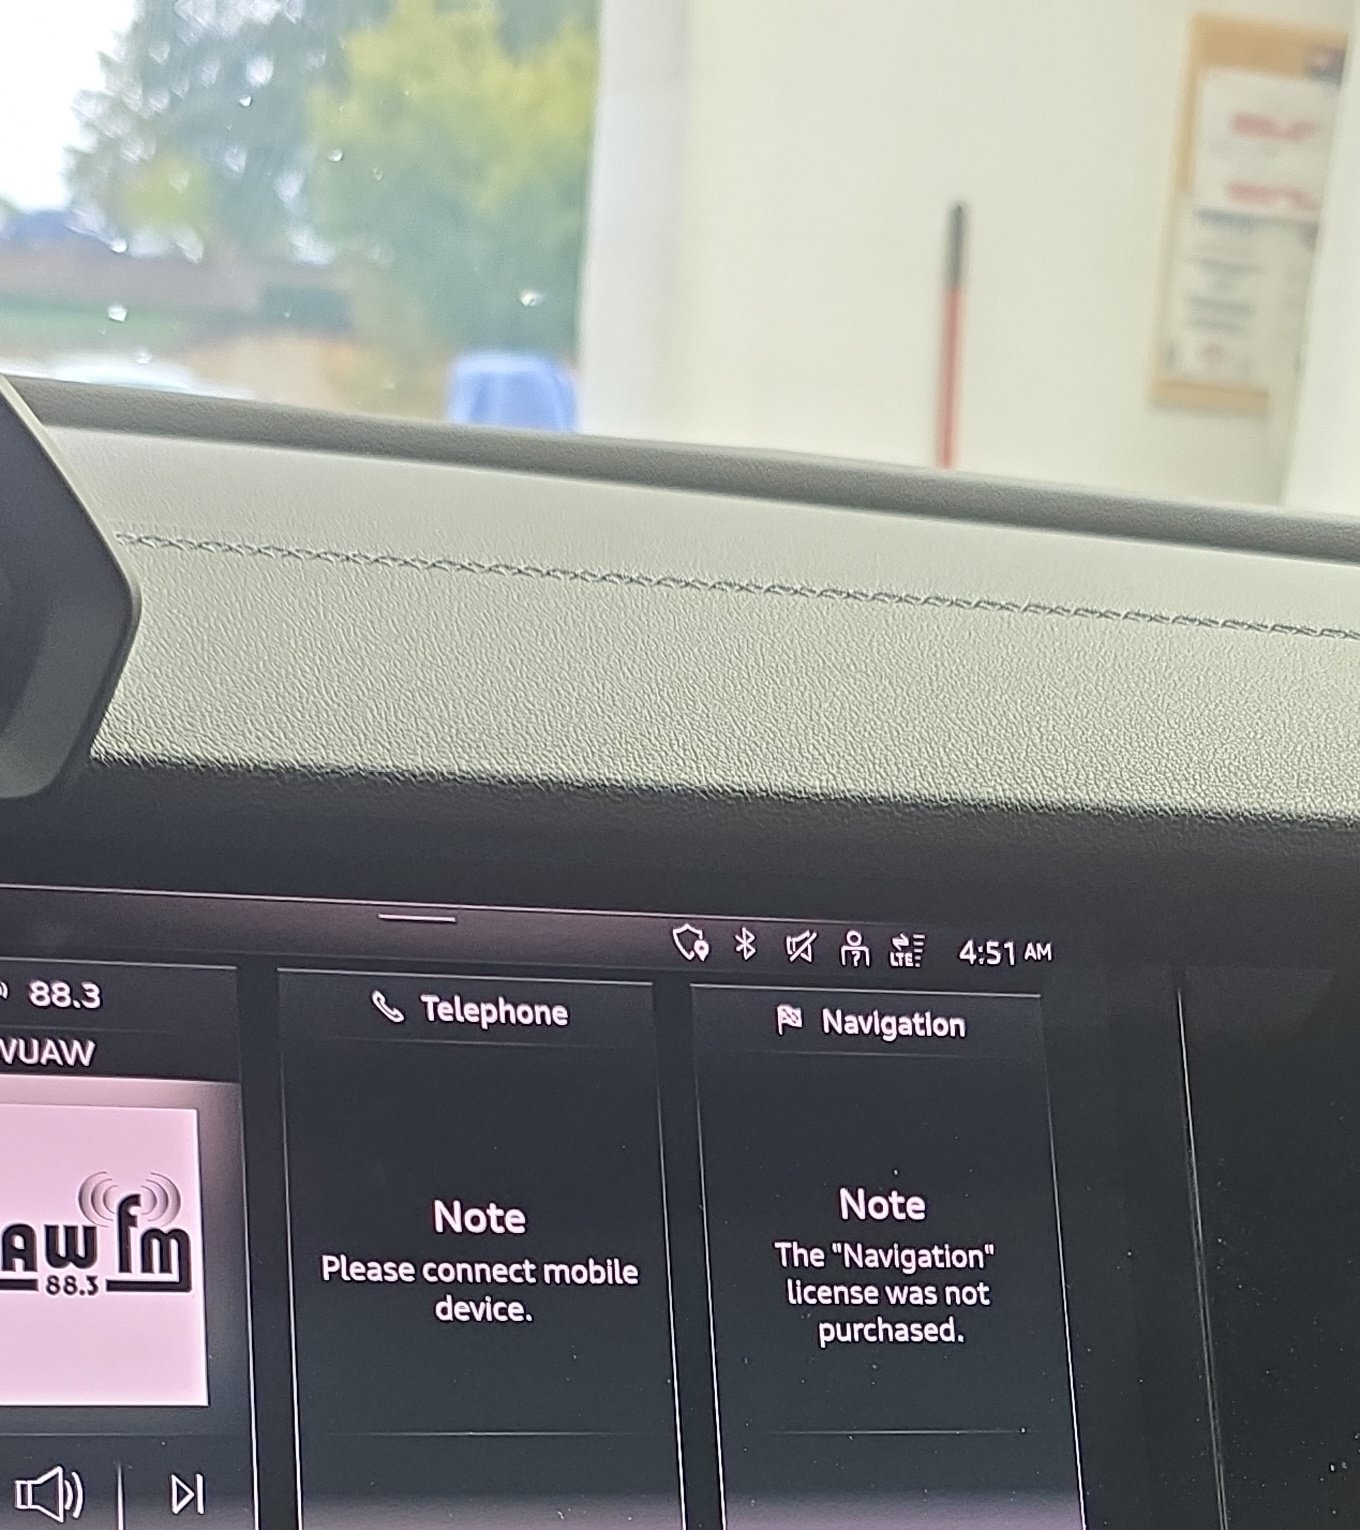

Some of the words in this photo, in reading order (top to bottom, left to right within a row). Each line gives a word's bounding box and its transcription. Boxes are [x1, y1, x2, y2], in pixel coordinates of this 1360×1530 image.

[889, 951, 915, 968] LTE
[959, 940, 1016, 966] 4:51
[1024, 943, 1052, 961] AM
[29, 981, 101, 1009] 88.3
[421, 994, 569, 1030] Telephone
[822, 1008, 966, 1042] Navigation
[434, 1199, 526, 1234] Note
[839, 1187, 926, 1220] Note
[322, 1254, 416, 1282] Please
[423, 1259, 537, 1284] connect
[543, 1257, 639, 1285] mobile
[774, 1241, 825, 1268] The
[831, 1242, 994, 1275] "Navigation"
[45, 1275, 99, 1296] 88.3
[787, 1278, 880, 1305] license
[885, 1285, 938, 1306] was
[944, 1281, 991, 1306] not
[435, 1294, 533, 1322] device.
[818, 1316, 964, 1349] purchased.
